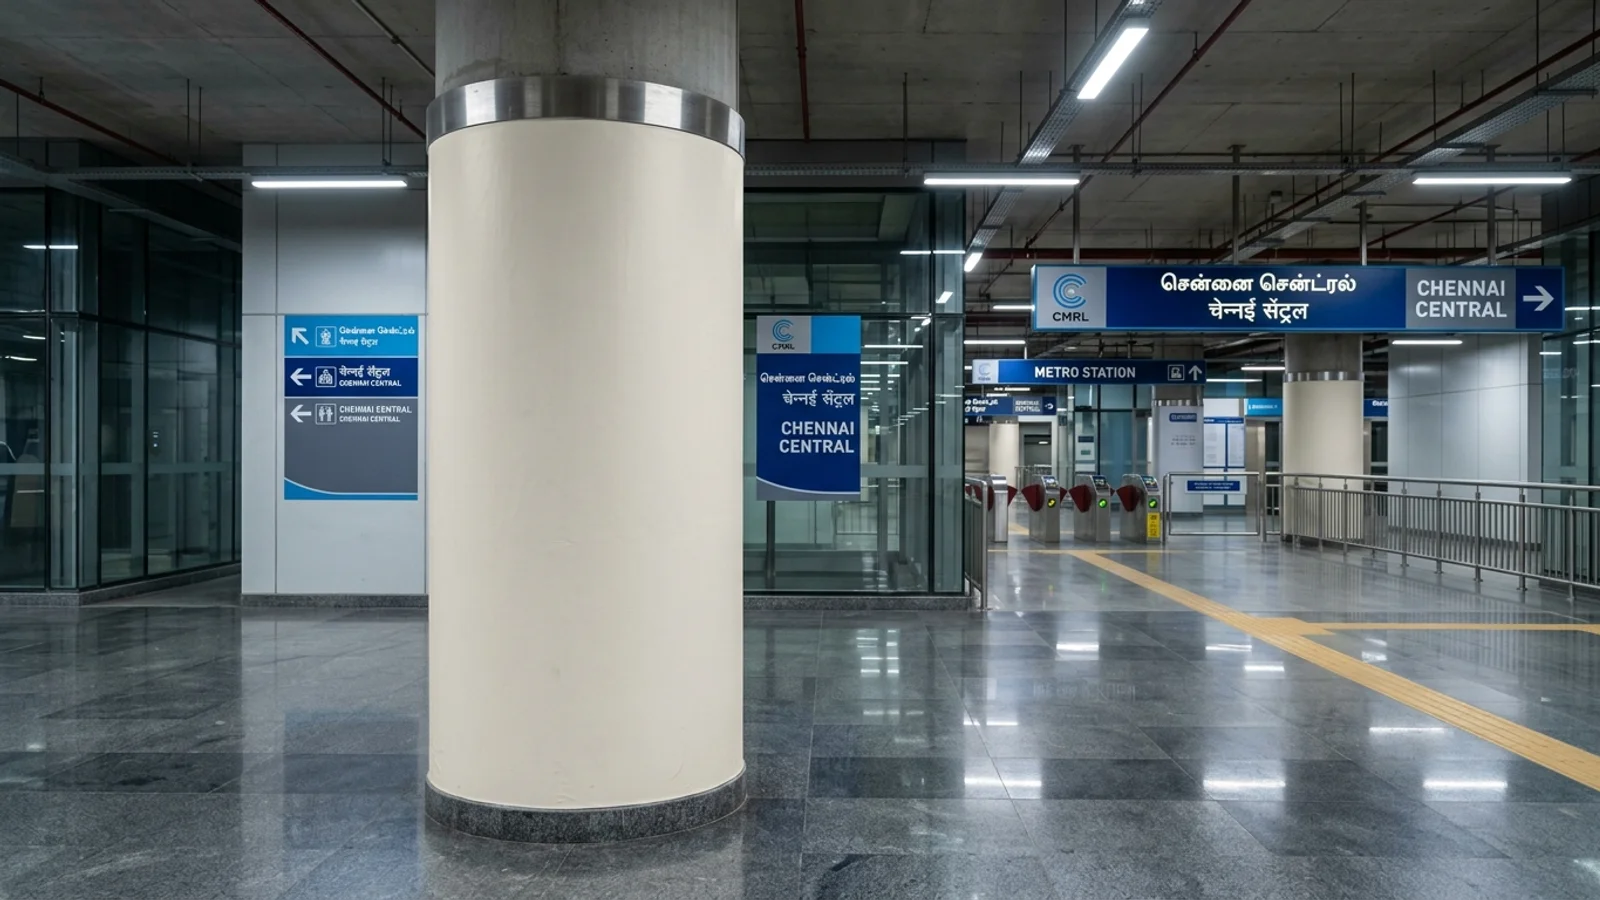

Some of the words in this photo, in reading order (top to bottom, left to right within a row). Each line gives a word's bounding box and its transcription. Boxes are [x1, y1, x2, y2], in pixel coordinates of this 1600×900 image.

[1160, 272, 1254, 291] சென்னை
[1259, 272, 1357, 294] சென்ட்ரல்
[1417, 279, 1505, 296] CHENNAI
[1052, 311, 1089, 322] CMRL
[1208, 297, 1256, 322] चेन्नई
[1415, 301, 1508, 318] CENTRAL
[1034, 366, 1079, 378] METRO
[1082, 366, 1136, 378] STATION
[781, 421, 855, 436] CHENNAI
[779, 439, 855, 454] CENTRAL
